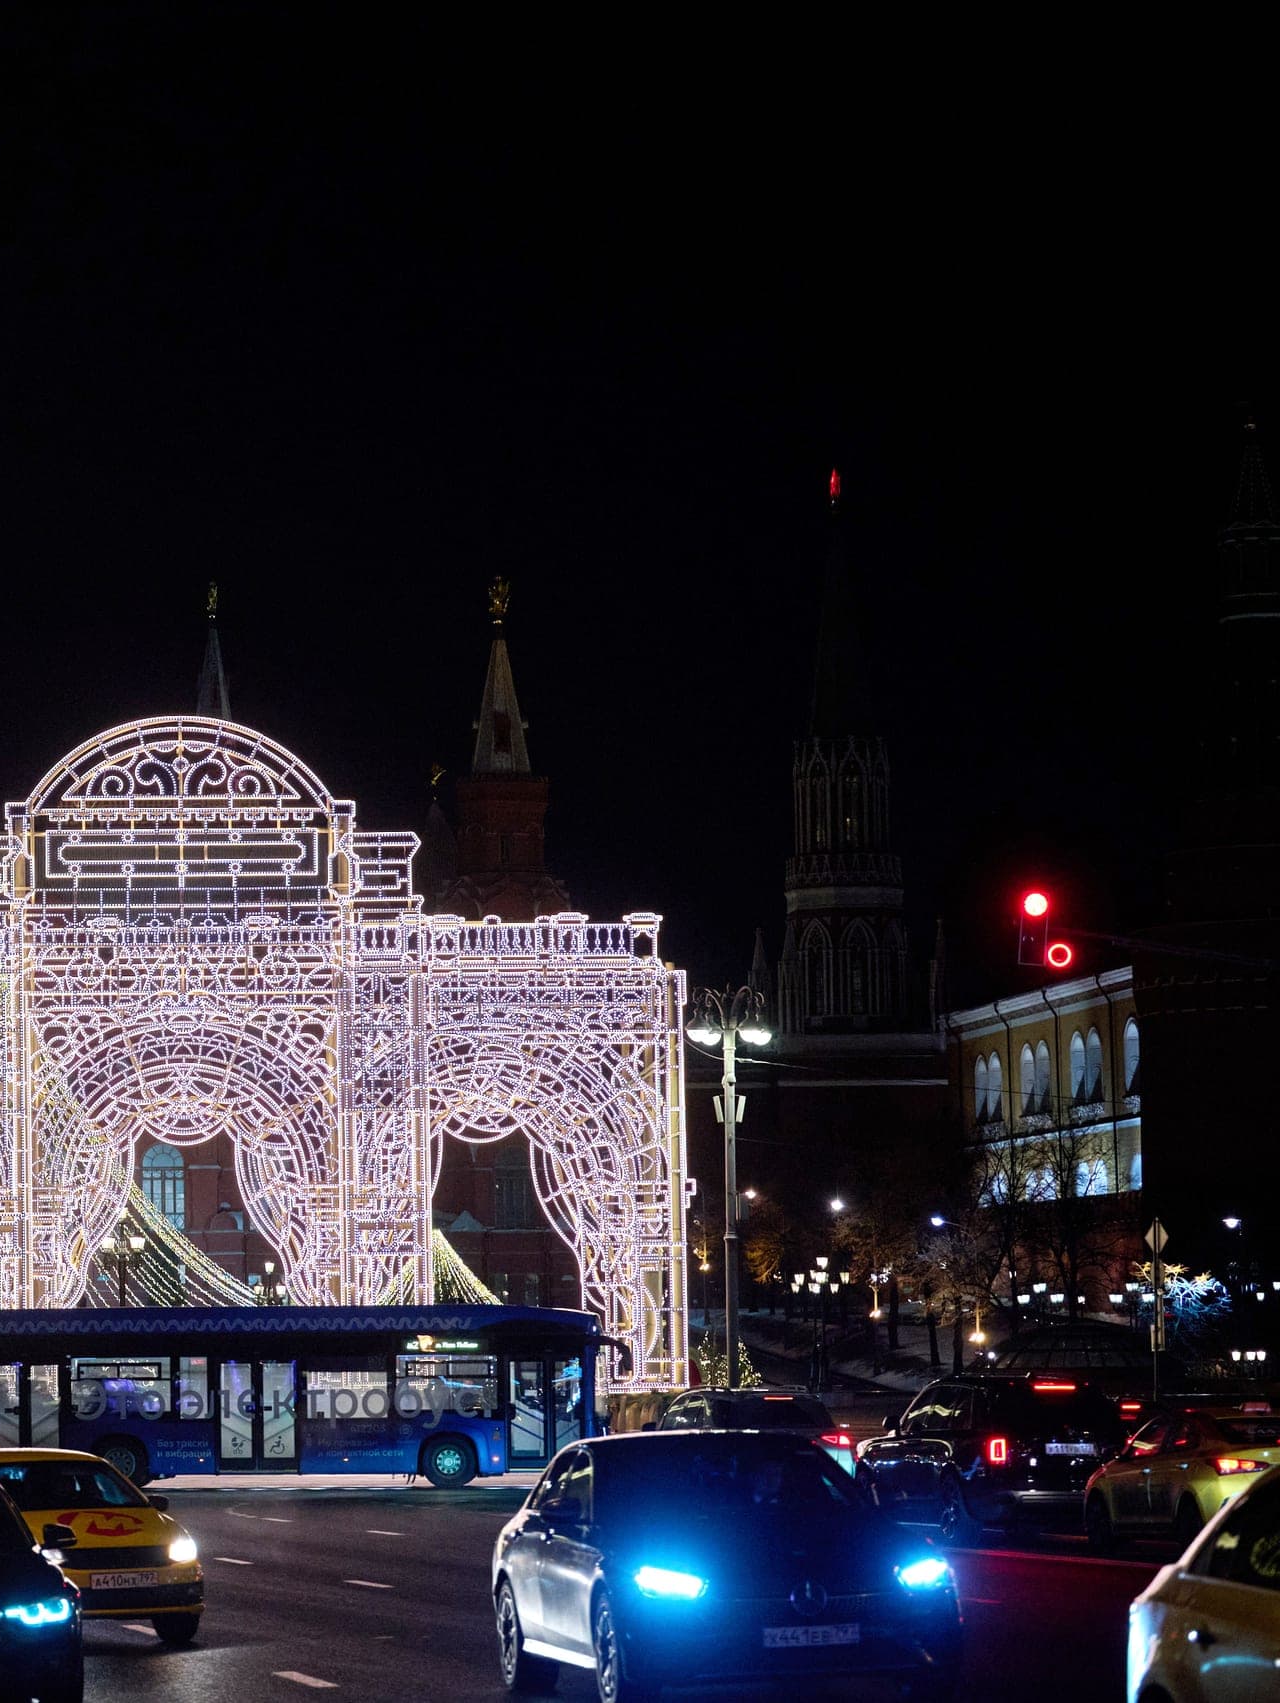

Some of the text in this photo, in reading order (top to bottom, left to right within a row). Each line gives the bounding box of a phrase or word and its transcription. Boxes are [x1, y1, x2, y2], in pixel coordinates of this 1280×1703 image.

[165, 1448, 212, 1460] вибраций
[326, 1448, 381, 1458] контактной
[382, 1449, 405, 1458] сети
